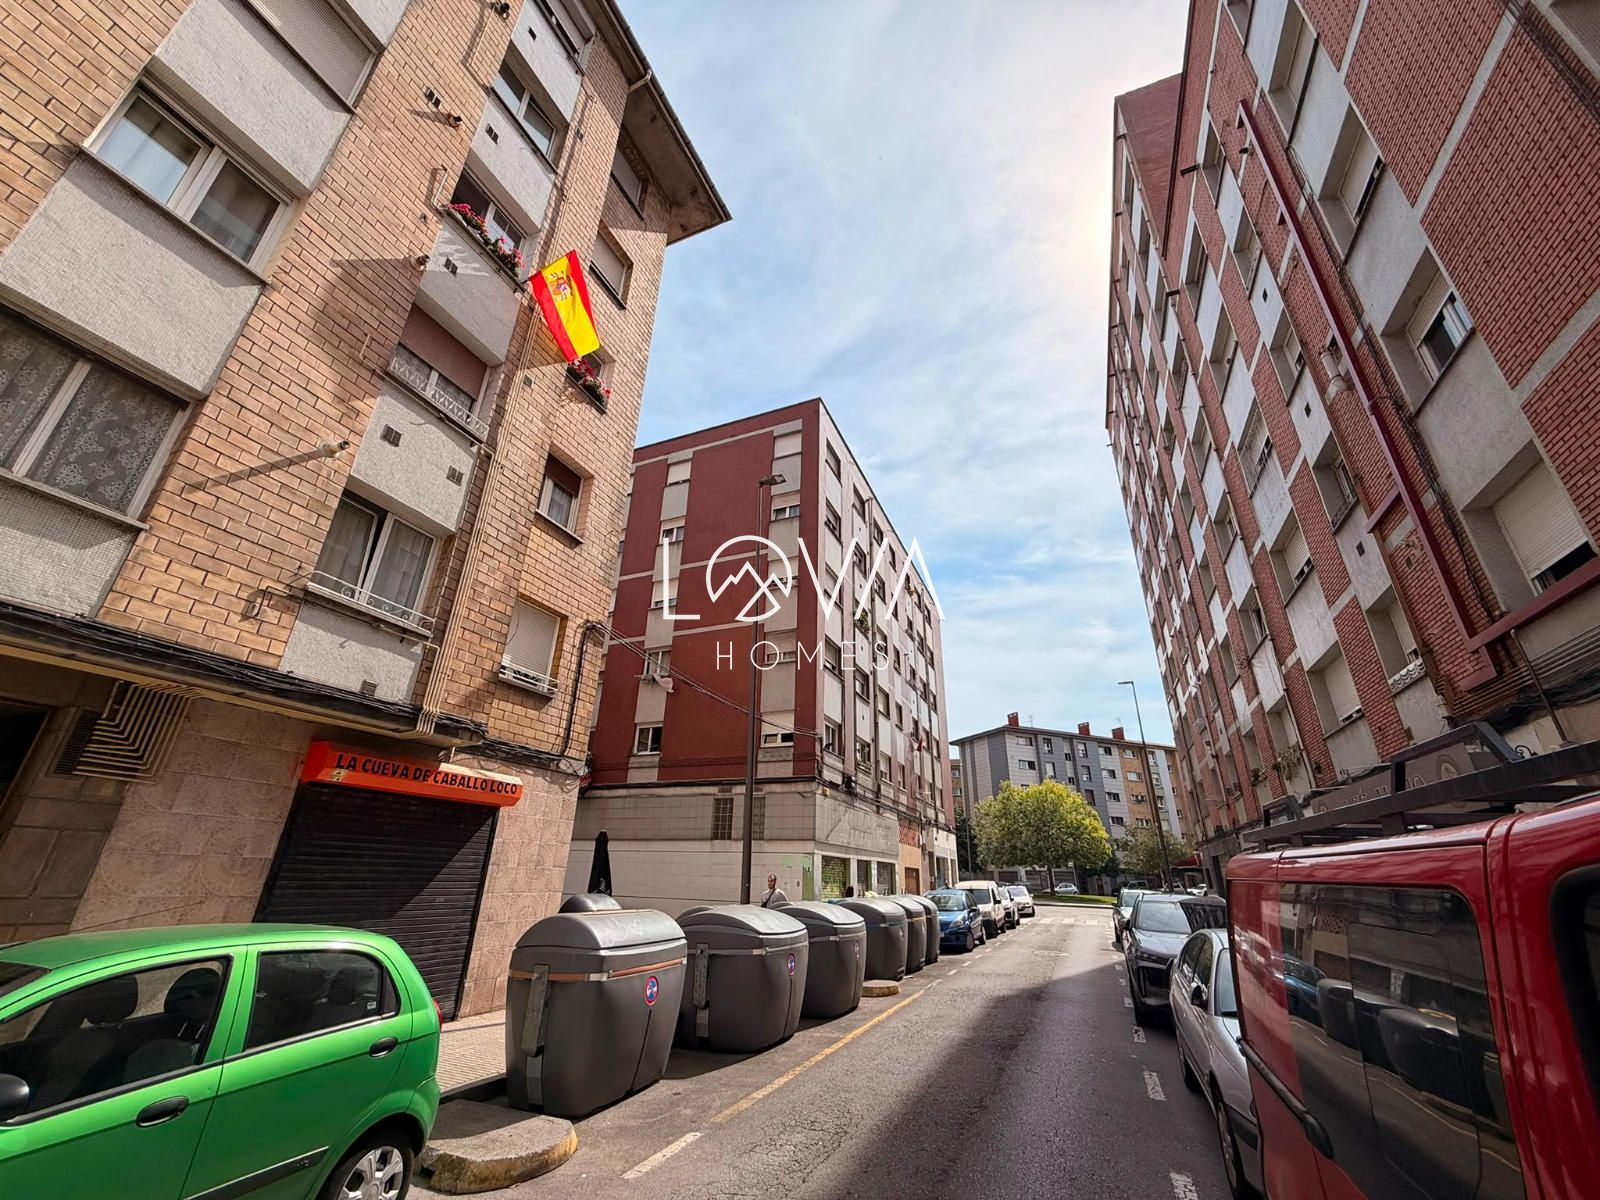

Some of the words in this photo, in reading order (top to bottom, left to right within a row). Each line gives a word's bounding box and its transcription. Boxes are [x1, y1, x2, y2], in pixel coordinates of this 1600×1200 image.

[336, 753, 357, 771] LA
[362, 758, 409, 779] CUEVA
[413, 766, 432, 782] DE
[433, 770, 488, 791] CABALLO
[489, 780, 518, 795] LOCO
